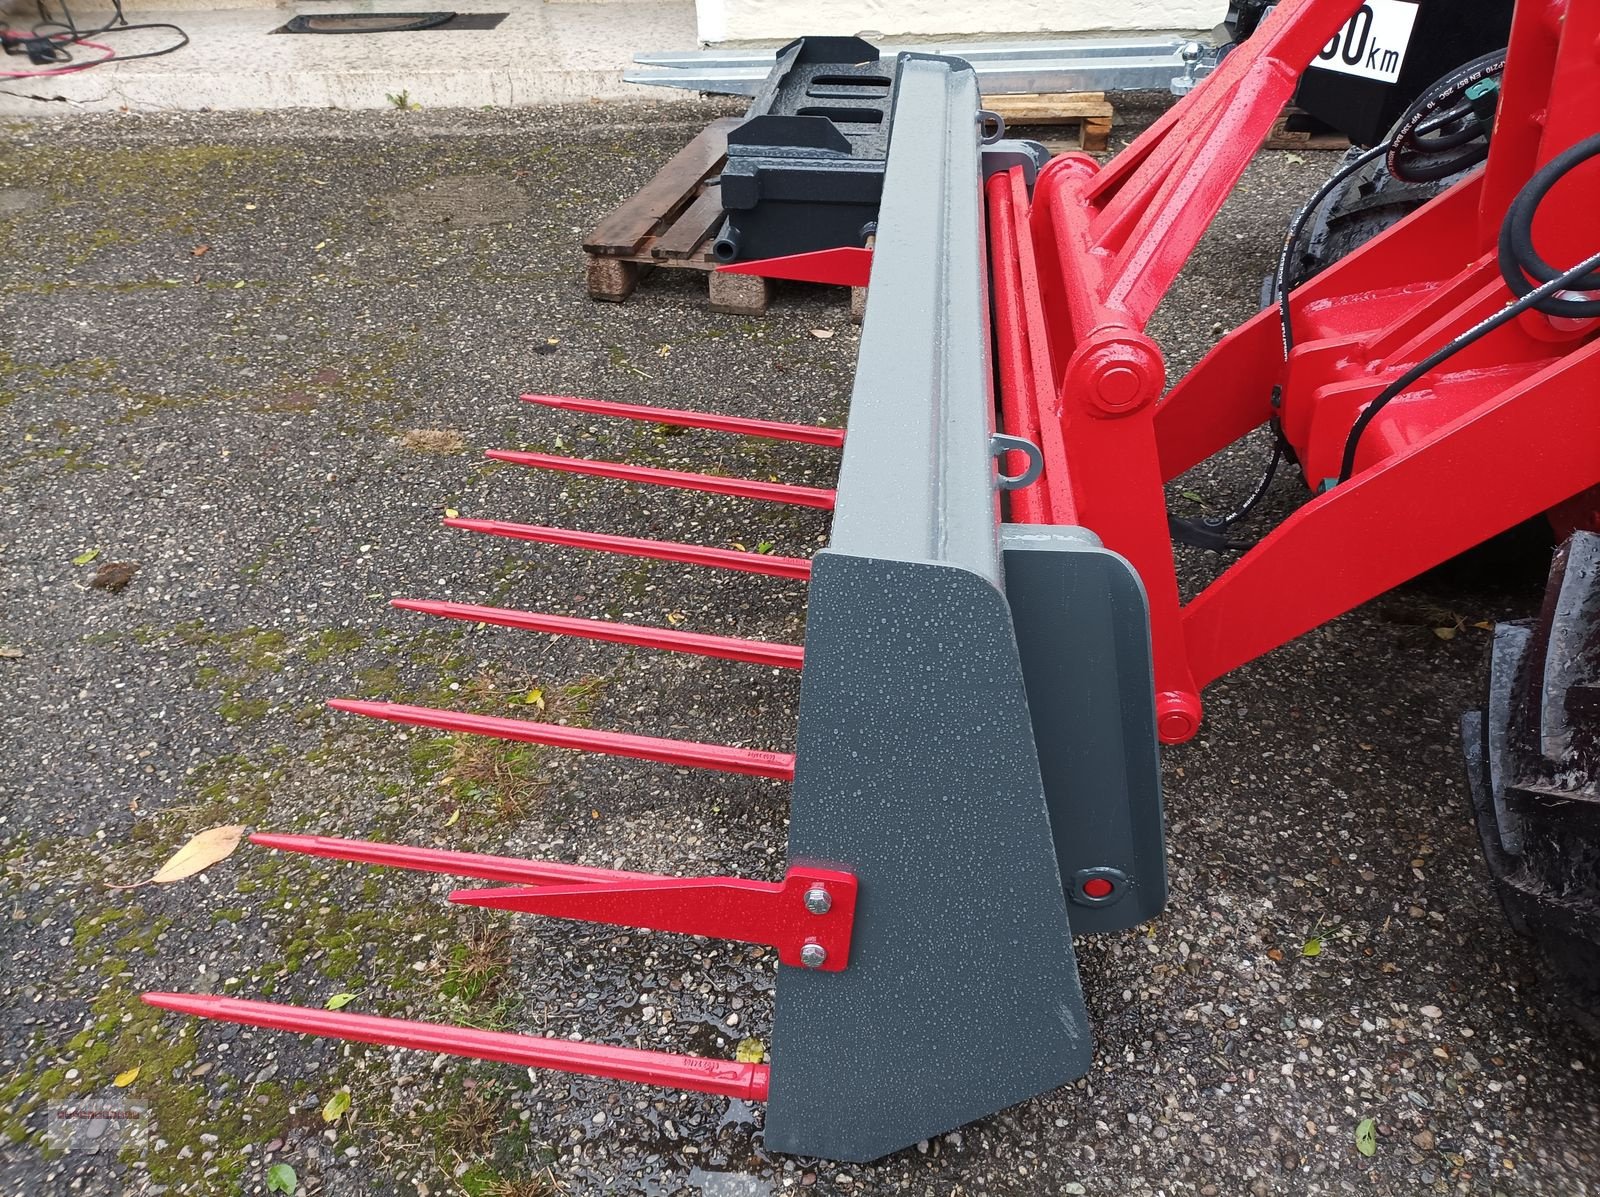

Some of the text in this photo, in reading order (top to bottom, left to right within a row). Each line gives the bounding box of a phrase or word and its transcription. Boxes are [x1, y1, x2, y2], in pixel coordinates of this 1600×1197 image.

[1365, 36, 1399, 73] km
[1469, 71, 1482, 82] EN
[1456, 78, 1470, 90] 857
[1438, 87, 1454, 101] 2SC
[1426, 101, 1436, 110] 10
[1411, 112, 1422, 125] WP
[1401, 121, 1412, 135] 330
[1392, 133, 1404, 148] BAR
